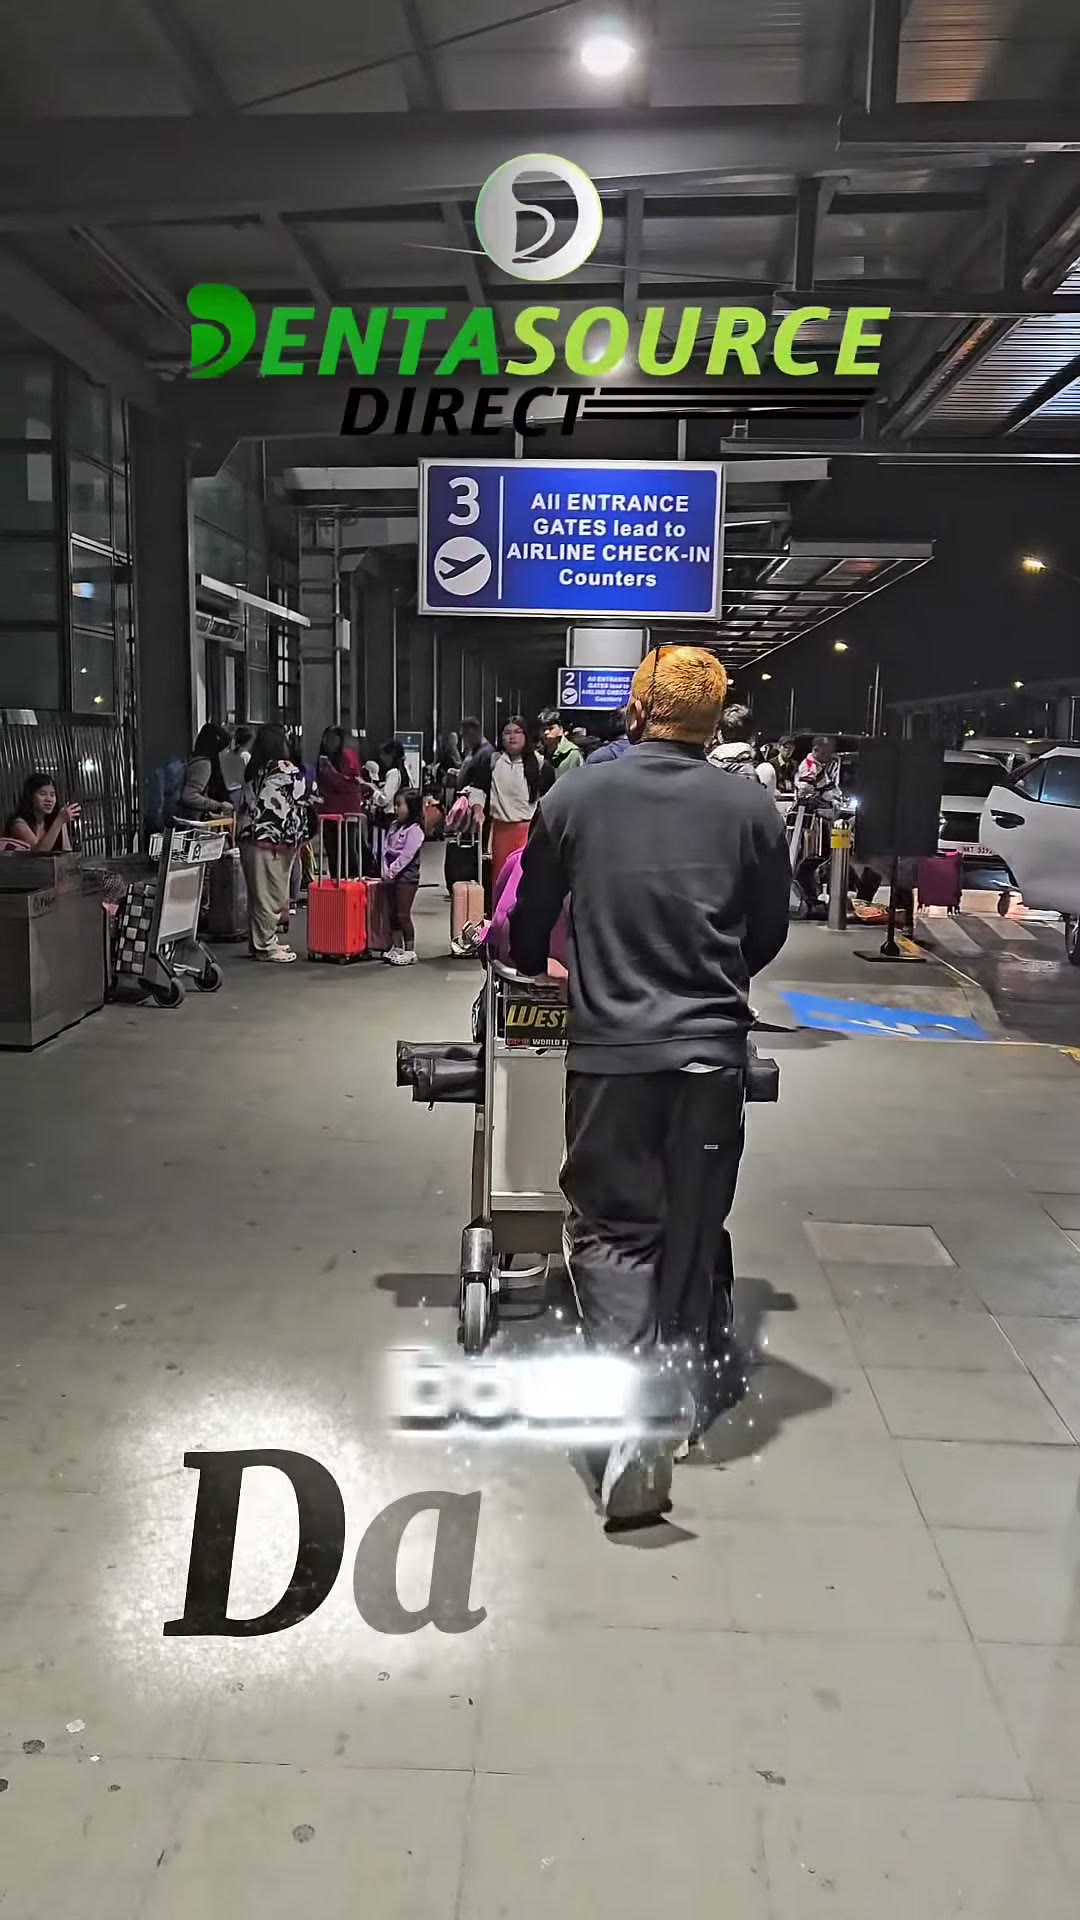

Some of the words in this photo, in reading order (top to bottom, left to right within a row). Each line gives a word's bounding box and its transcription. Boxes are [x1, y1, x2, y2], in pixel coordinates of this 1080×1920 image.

[447, 476, 481, 526] 3
[531, 493, 560, 510] All
[567, 493, 689, 513] ENTRANCE
[533, 518, 606, 536] GATES
[614, 520, 658, 537] lead
[665, 522, 686, 537] to
[507, 543, 595, 560] AIRLINE
[602, 544, 710, 563] CHECK-IN
[559, 568, 657, 587] Counters
[565, 672, 575, 686] 2
[532, 1038, 560, 1046] WORLD
